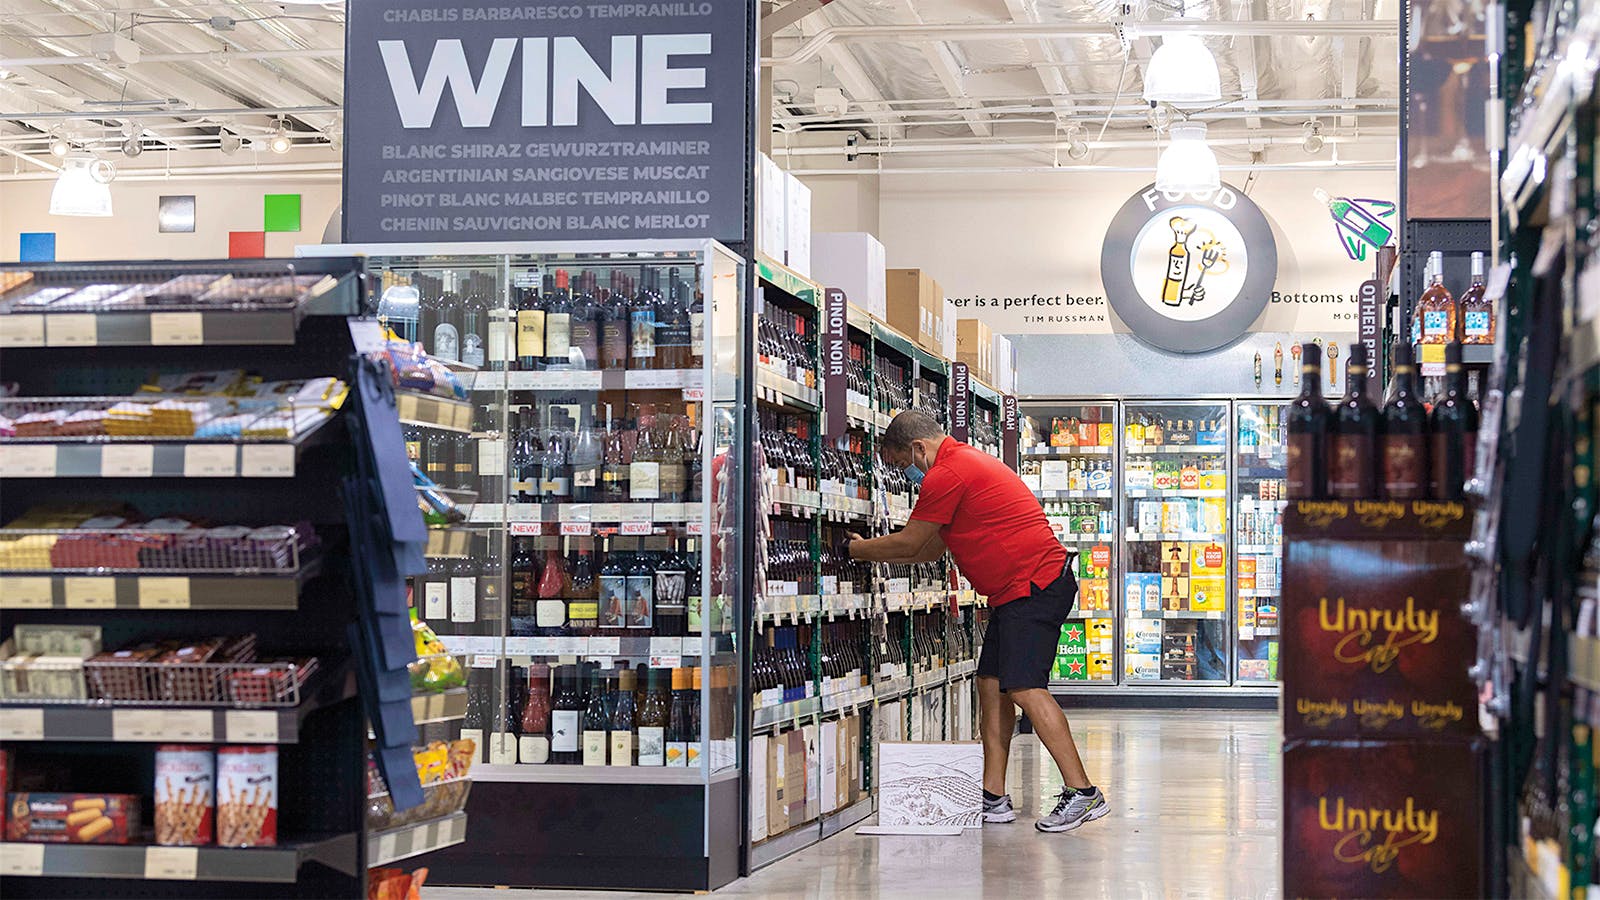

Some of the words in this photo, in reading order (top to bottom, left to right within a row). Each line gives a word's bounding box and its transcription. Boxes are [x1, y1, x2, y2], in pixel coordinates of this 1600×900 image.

[384, 7, 458, 23] CHABLIS
[462, 5, 583, 21] BARBARESCO
[587, 2, 712, 19] TEMPRANILLO
[378, 33, 712, 128] WINE
[382, 145, 447, 160] BLANC
[450, 143, 522, 159] SHIRAZ
[525, 141, 710, 158] GEWURZTRAMINER
[382, 168, 508, 183] ARGENTINIAN
[512, 167, 629, 182] SANGIOVESE
[633, 165, 710, 181] MUSCAT
[381, 193, 436, 208] PINOT
[439, 192, 501, 207] BLANC
[504, 191, 578, 206] MALBEC
[581, 190, 710, 205] TEMPRANILLO
[380, 217, 449, 232] CHENIN
[452, 216, 562, 231] SAUVIGNON
[566, 215, 630, 230] BLANC
[634, 214, 710, 229] MERLOT
[975, 294, 987, 307] is
[991, 298, 1000, 307] a
[1003, 293, 1062, 310] perfect
[1066, 293, 1105, 306] beer.
[1271, 291, 1344, 304] Bottoms
[1350, 294, 1359, 303] u
[830, 292, 844, 337] PINOT
[1024, 315, 1045, 323] TIM
[1048, 314, 1105, 323] RUSSMAN
[1362, 285, 1376, 336] OTHER
[830, 340, 844, 375] NOIR
[956, 365, 966, 399] PINOT
[956, 401, 966, 428] NOIR
[1006, 398, 1015, 430] SYRAH
[513, 525, 539, 533] NEW!
[563, 525, 589, 533] NEW!
[623, 525, 649, 533] NEW!
[1318, 596, 1439, 644] Unruly
[1318, 796, 1439, 845] Unruly
